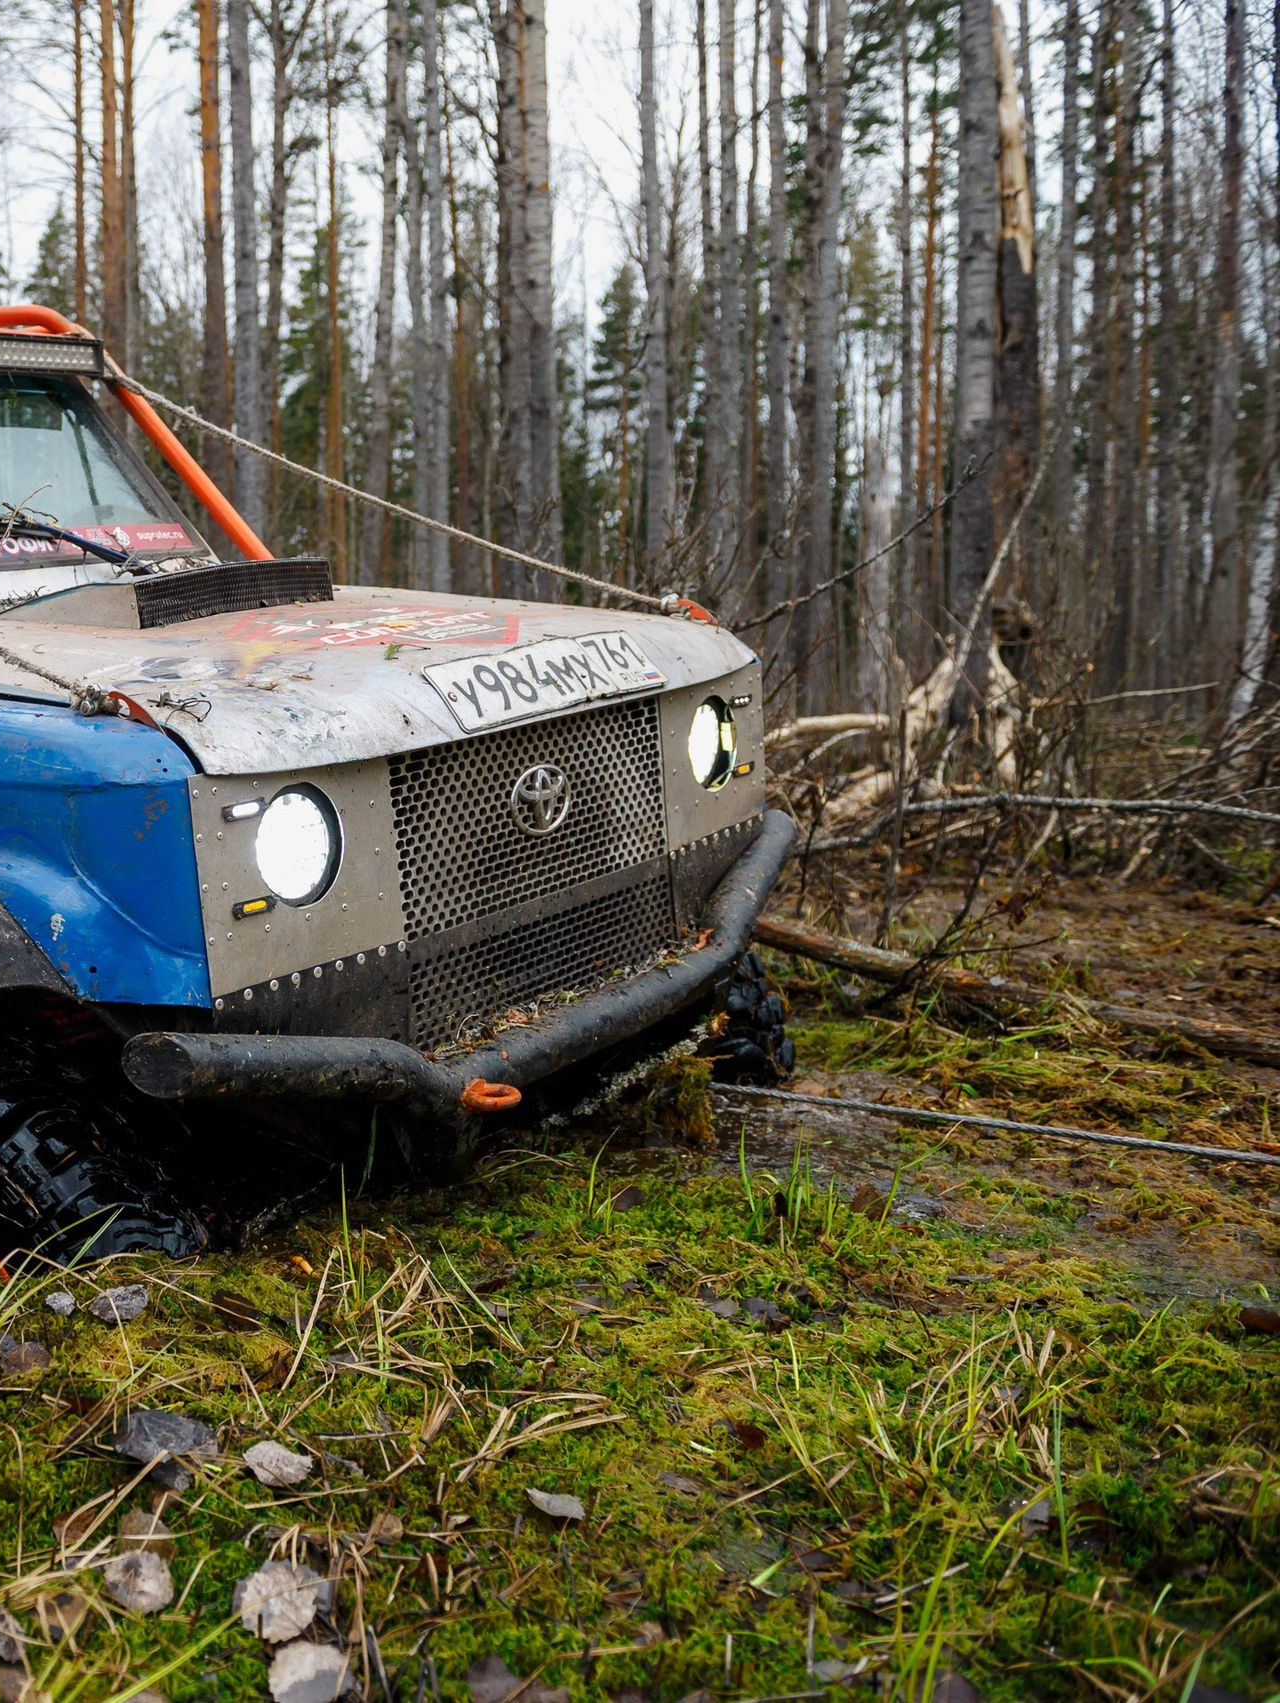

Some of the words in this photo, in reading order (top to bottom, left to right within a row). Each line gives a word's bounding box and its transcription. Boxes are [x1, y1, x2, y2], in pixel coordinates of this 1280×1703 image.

[136, 531, 184, 541] suprotec.ru
[581, 637, 646, 672] 761
[620, 671, 645, 685] RUS
